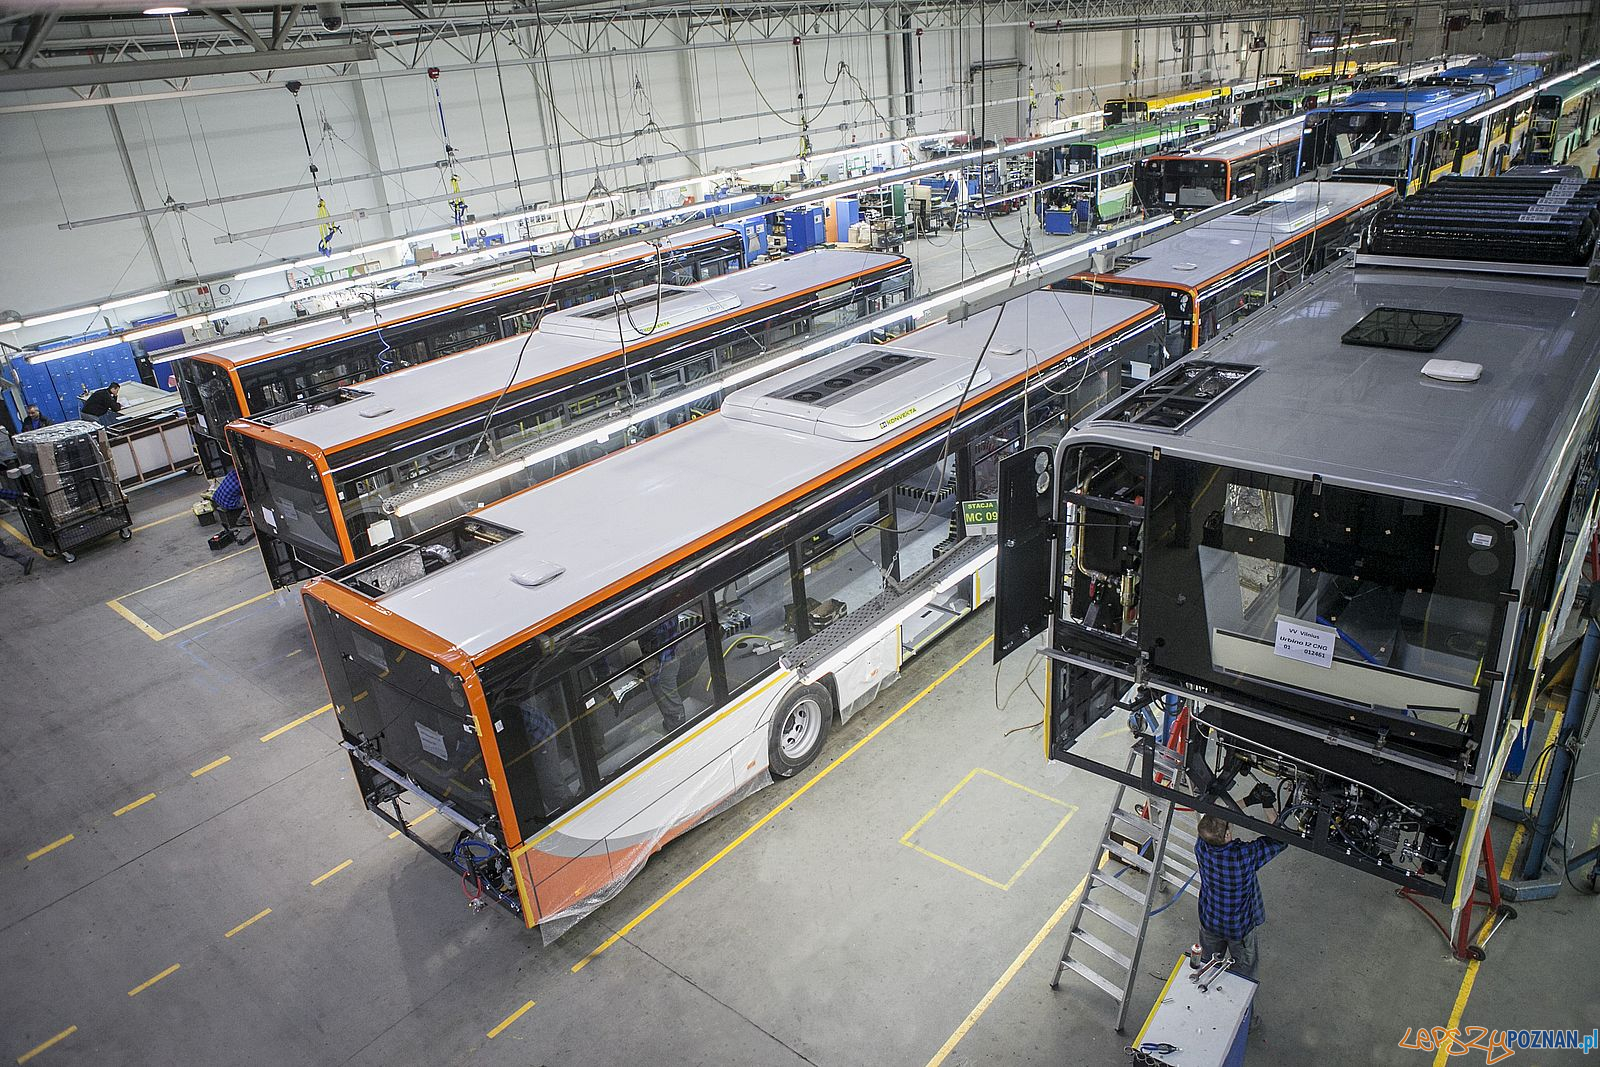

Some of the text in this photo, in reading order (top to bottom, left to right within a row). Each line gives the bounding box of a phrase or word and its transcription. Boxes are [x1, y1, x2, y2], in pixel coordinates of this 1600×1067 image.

[886, 407, 917, 425] KONVEKTA
[965, 511, 998, 523] MC 09
[1300, 630, 1320, 640] Vilnius
[1279, 636, 1304, 646] Urbino
[1312, 643, 1328, 651] CNG
